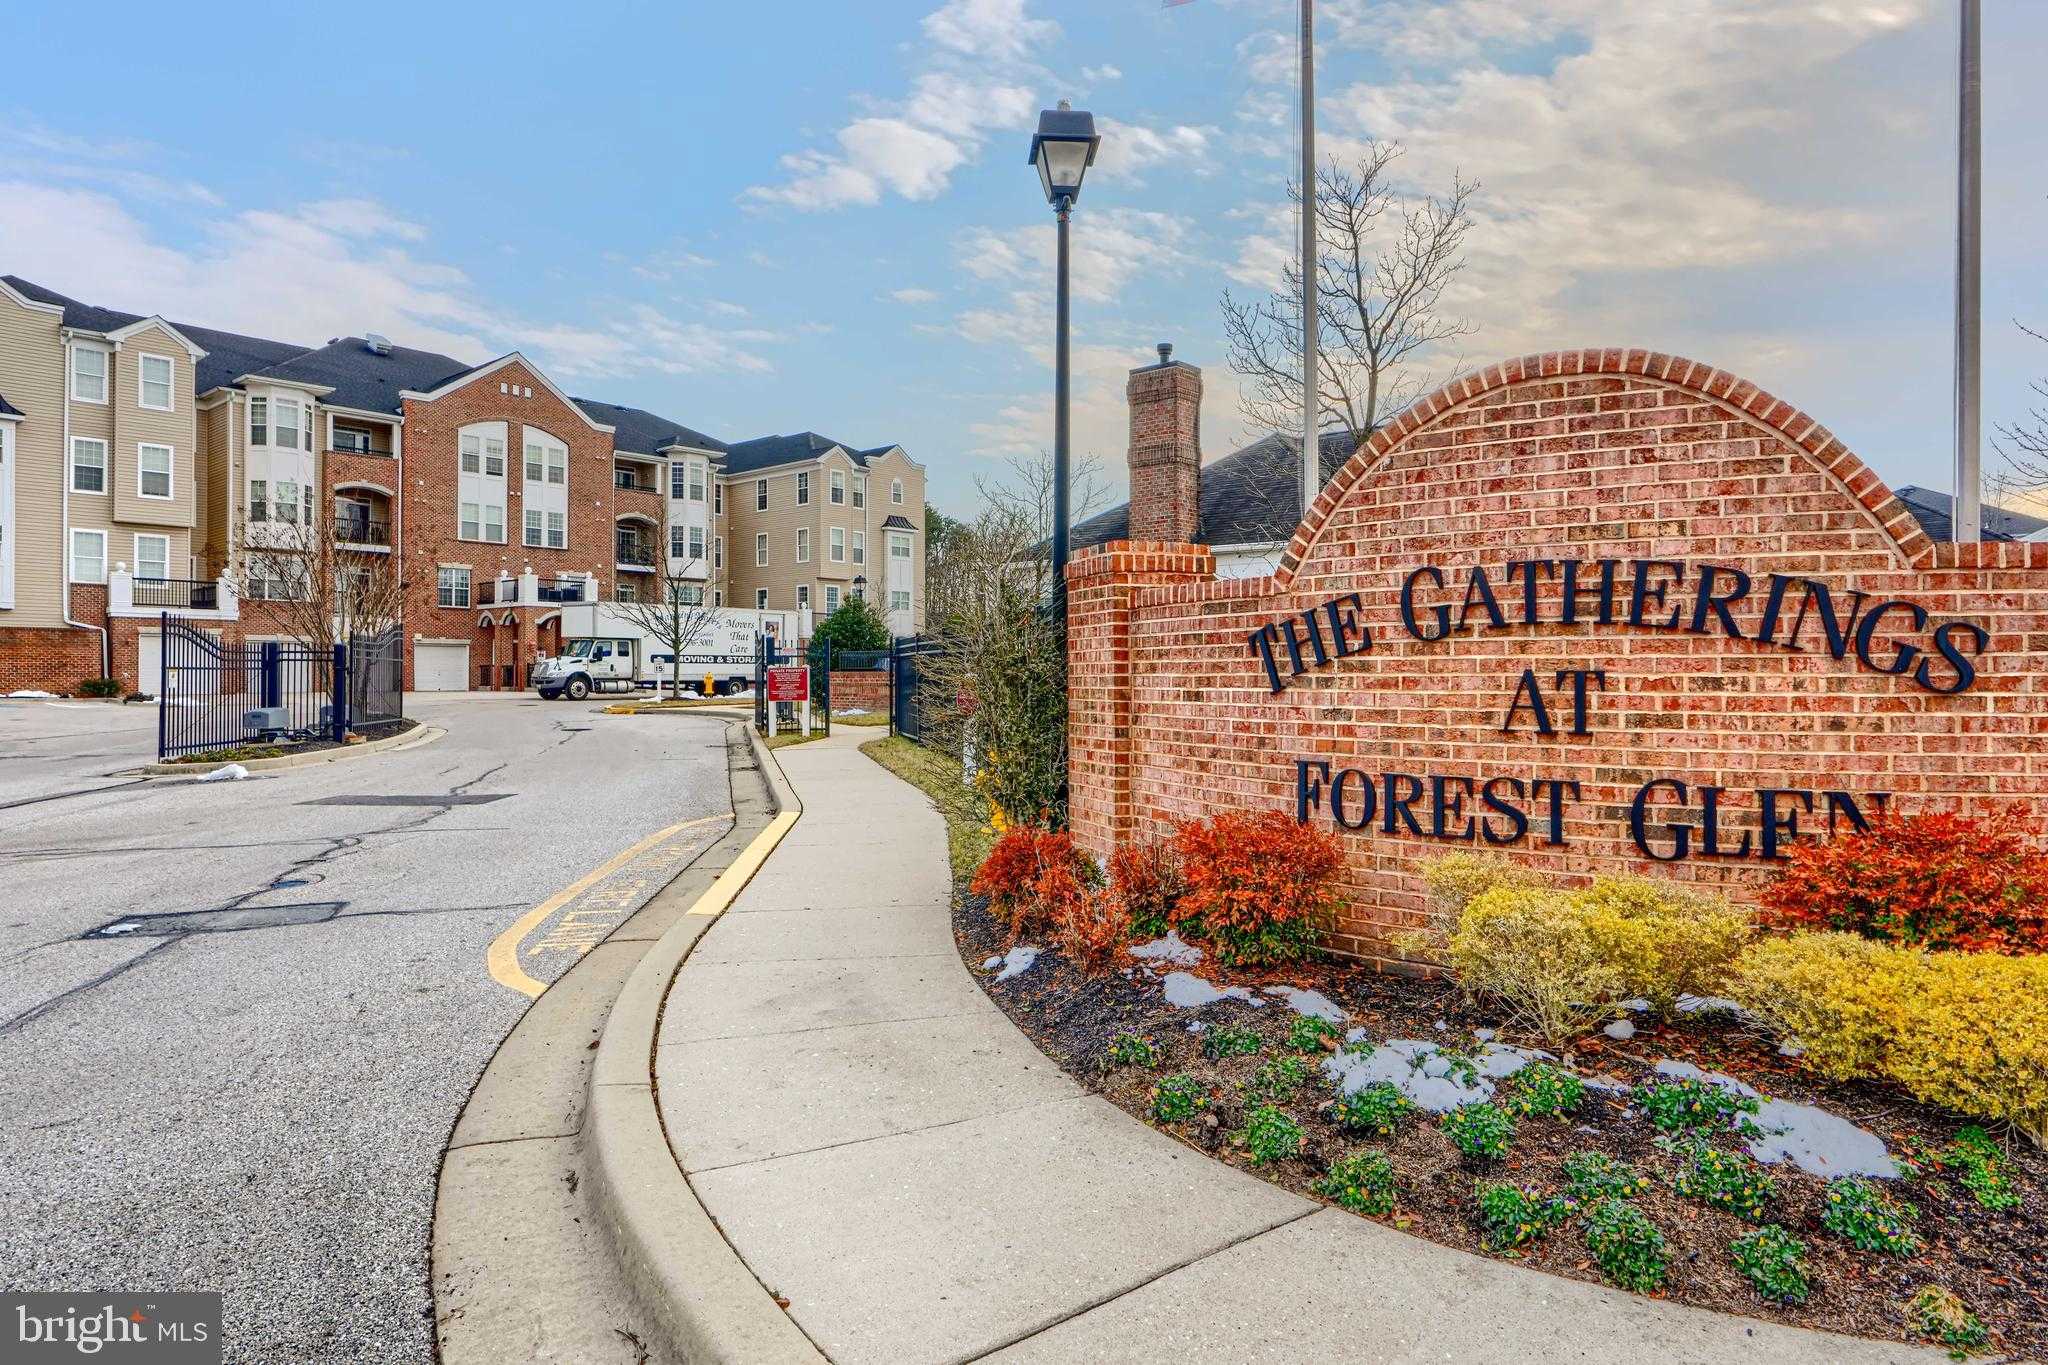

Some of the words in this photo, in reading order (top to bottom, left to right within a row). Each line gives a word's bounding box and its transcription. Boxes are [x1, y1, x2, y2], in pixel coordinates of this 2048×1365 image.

[725, 619, 755, 629] Movers
[730, 631, 749, 641] That
[1247, 593, 1372, 696] THE
[1400, 559, 1990, 694] GATHERINGS
[726, 656, 756, 664] STORA
[1502, 669, 1606, 735] AT
[1295, 760, 1580, 846] FOREST
[1631, 778, 1892, 860] GLEN
